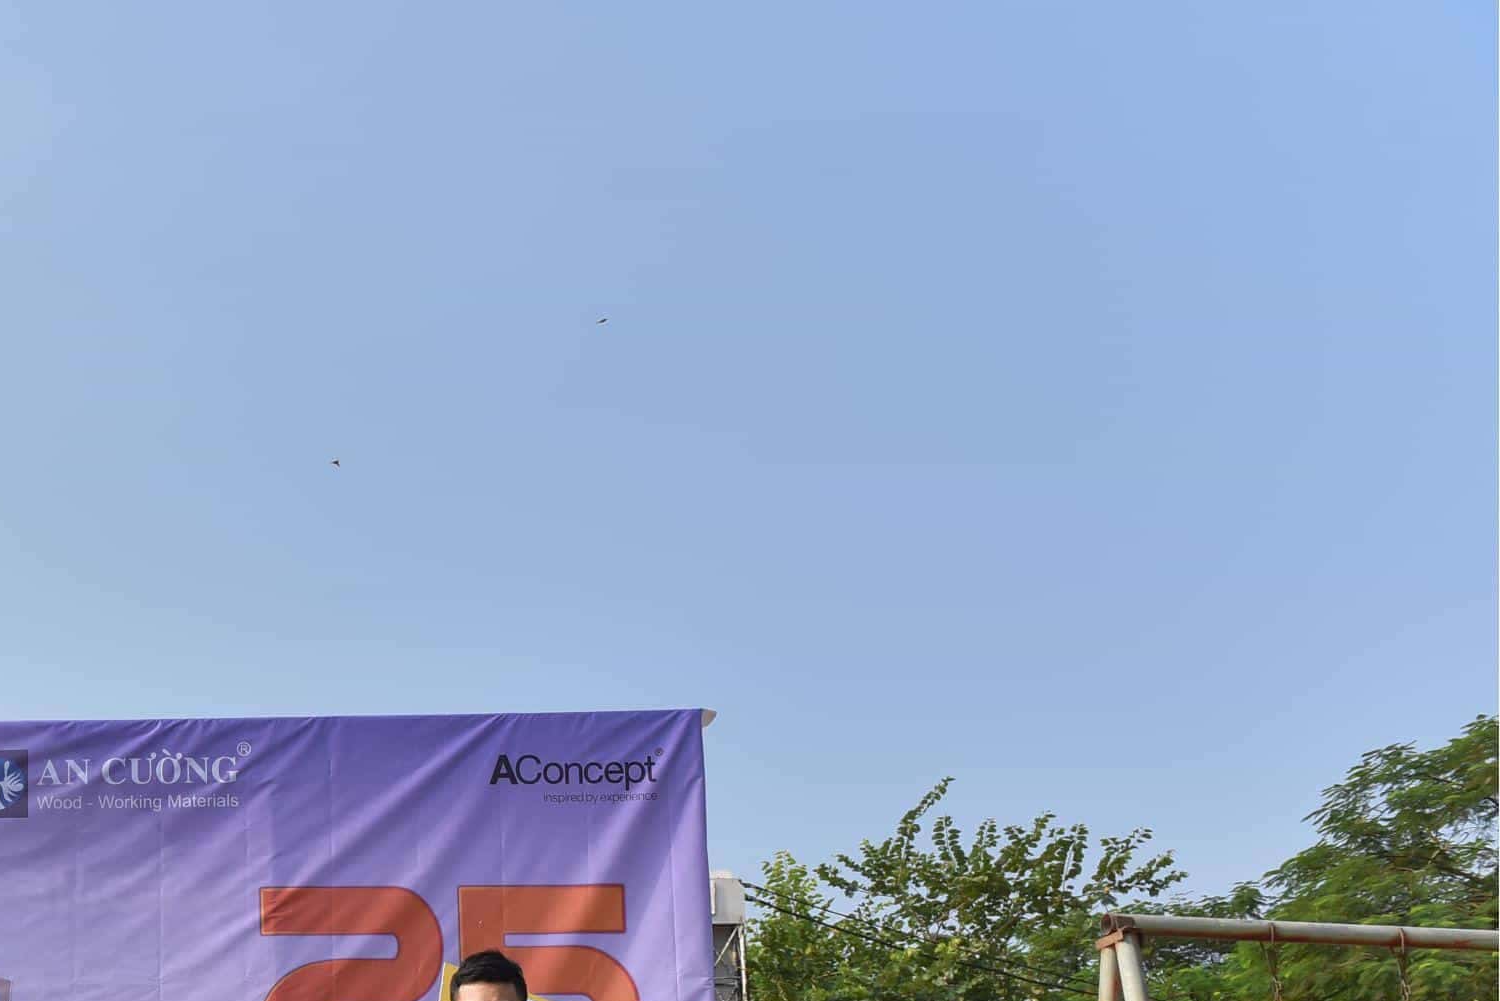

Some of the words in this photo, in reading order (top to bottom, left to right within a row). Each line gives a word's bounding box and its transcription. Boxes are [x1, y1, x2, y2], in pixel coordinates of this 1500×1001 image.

[36, 759, 90, 785] AN
[101, 748, 240, 785] CƯỜNG
[489, 754, 657, 791] AConcept
[36, 795, 83, 810] Wood
[98, 794, 162, 813] Working
[167, 793, 240, 809] Materials
[543, 791, 584, 803] inspired
[587, 791, 598, 804] by
